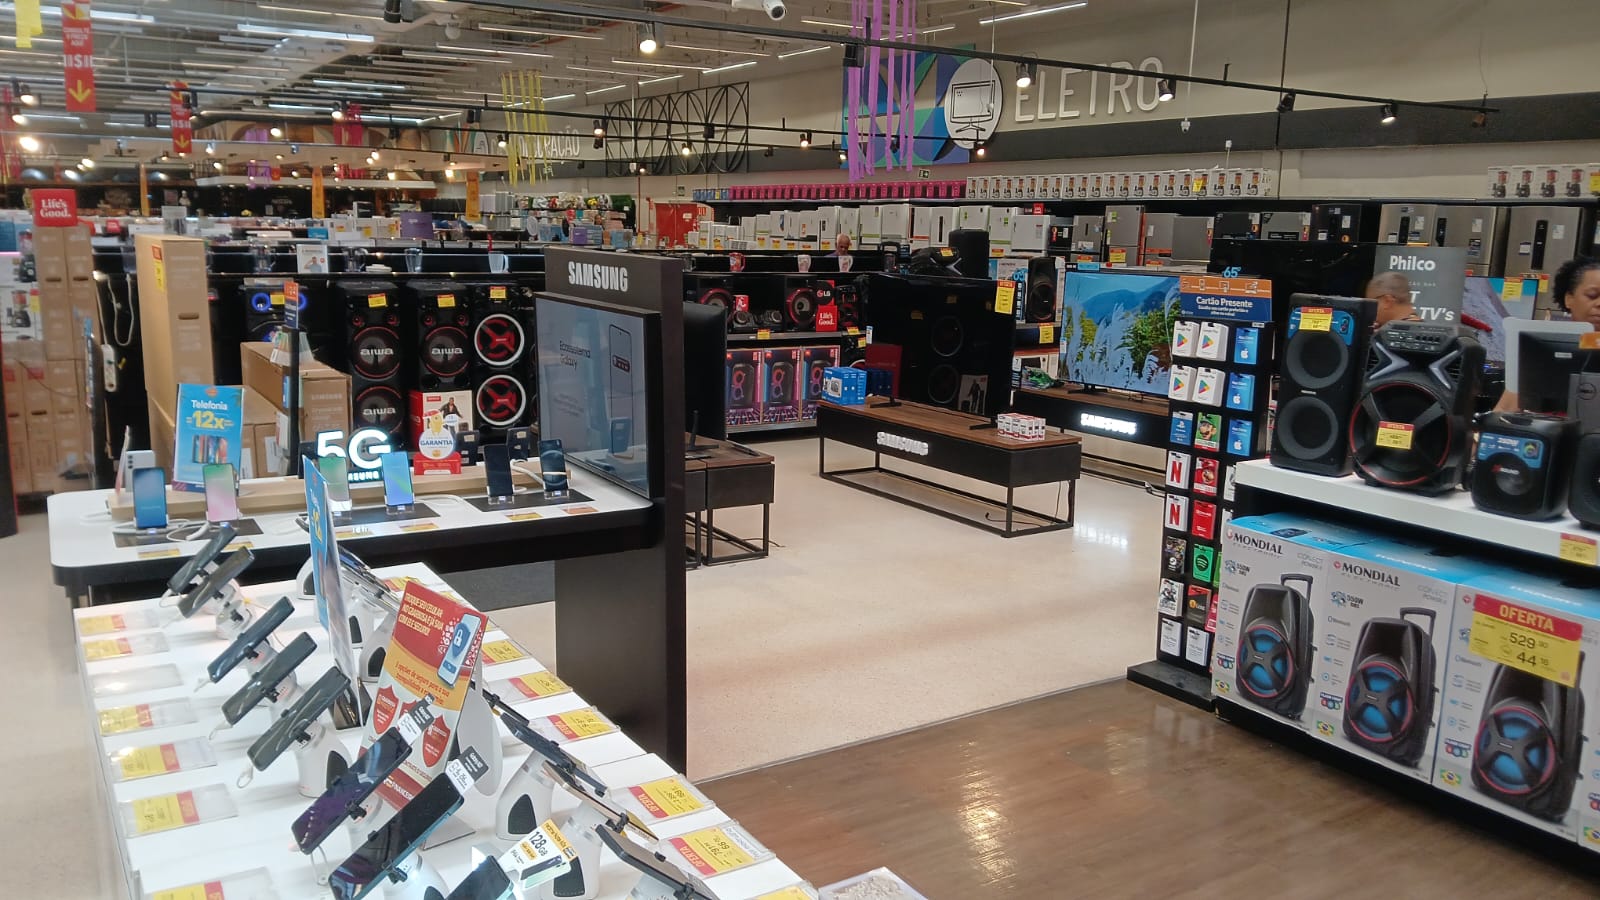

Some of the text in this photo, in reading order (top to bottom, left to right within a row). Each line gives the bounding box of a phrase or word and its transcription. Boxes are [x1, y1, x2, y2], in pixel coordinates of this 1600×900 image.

[1015, 57, 1164, 122] ELETRO
[41, 198, 67, 208] Life's
[40, 207, 72, 218] Good.
[1389, 256, 1436, 271] Philco
[568, 261, 628, 293] SAMSUNG
[1196, 296, 1253, 308] Cartão Presente
[1420, 307, 1455, 320] TV's
[360, 347, 394, 356] aiwa
[431, 347, 463, 355] aiwa
[191, 399, 228, 410] Telefonia
[363, 407, 396, 416] aiwa
[193, 410, 225, 429] 12x
[318, 429, 392, 469] 5G
[877, 431, 929, 456] SAMSUNG
[1233, 533, 1283, 555] MONDIAL
[1342, 563, 1401, 586] MONDIAL
[1499, 605, 1554, 632] OFERTA
[1509, 632, 1535, 649] 529
[1517, 651, 1537, 667] 44
[638, 793, 659, 812] OFERTA
[679, 845, 705, 867] OFERTA
